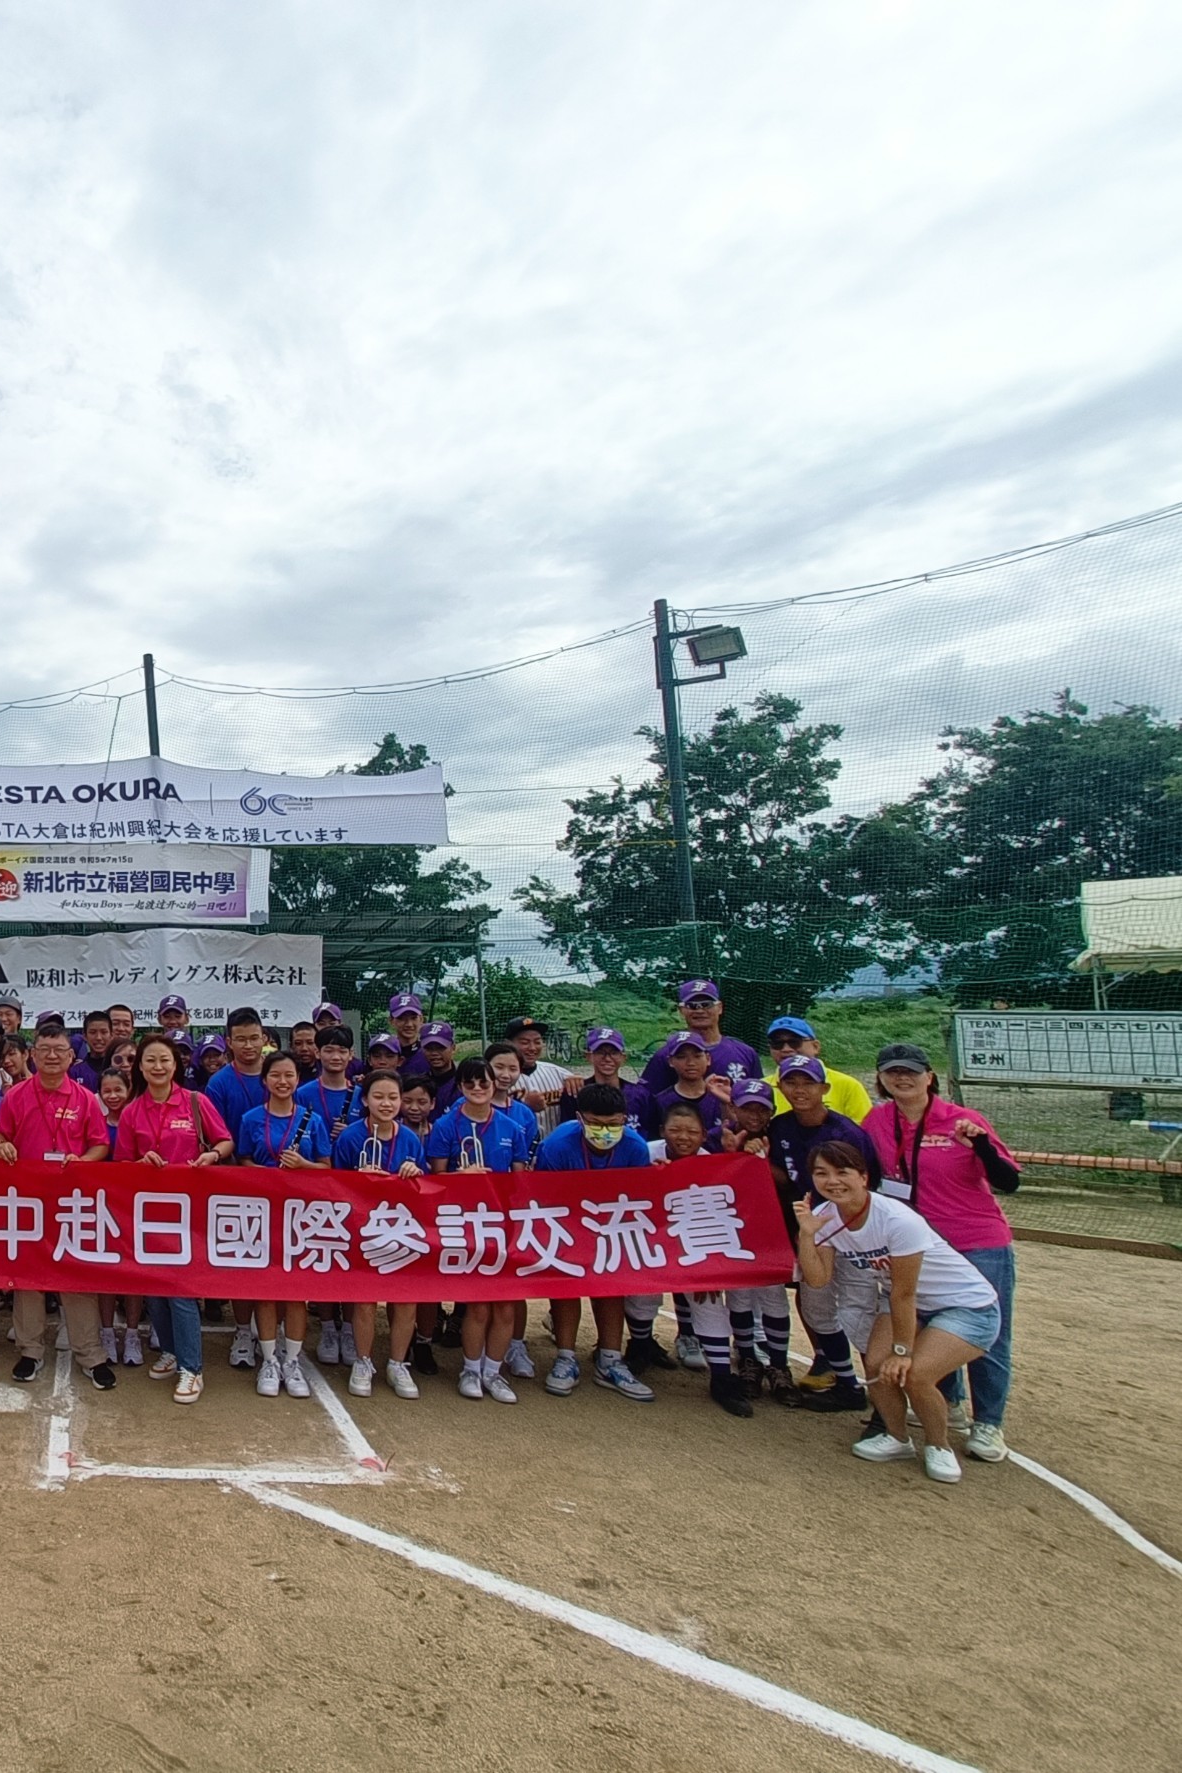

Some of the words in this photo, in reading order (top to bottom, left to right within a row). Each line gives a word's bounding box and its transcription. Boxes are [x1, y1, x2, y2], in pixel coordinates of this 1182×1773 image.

[72, 777, 184, 804] OKURA
[22, 870, 236, 895] 新北市立福營國民中學
[26, 963, 307, 988] 阪和ホールディングス株式会社
[968, 1020, 1003, 1028] TEAM
